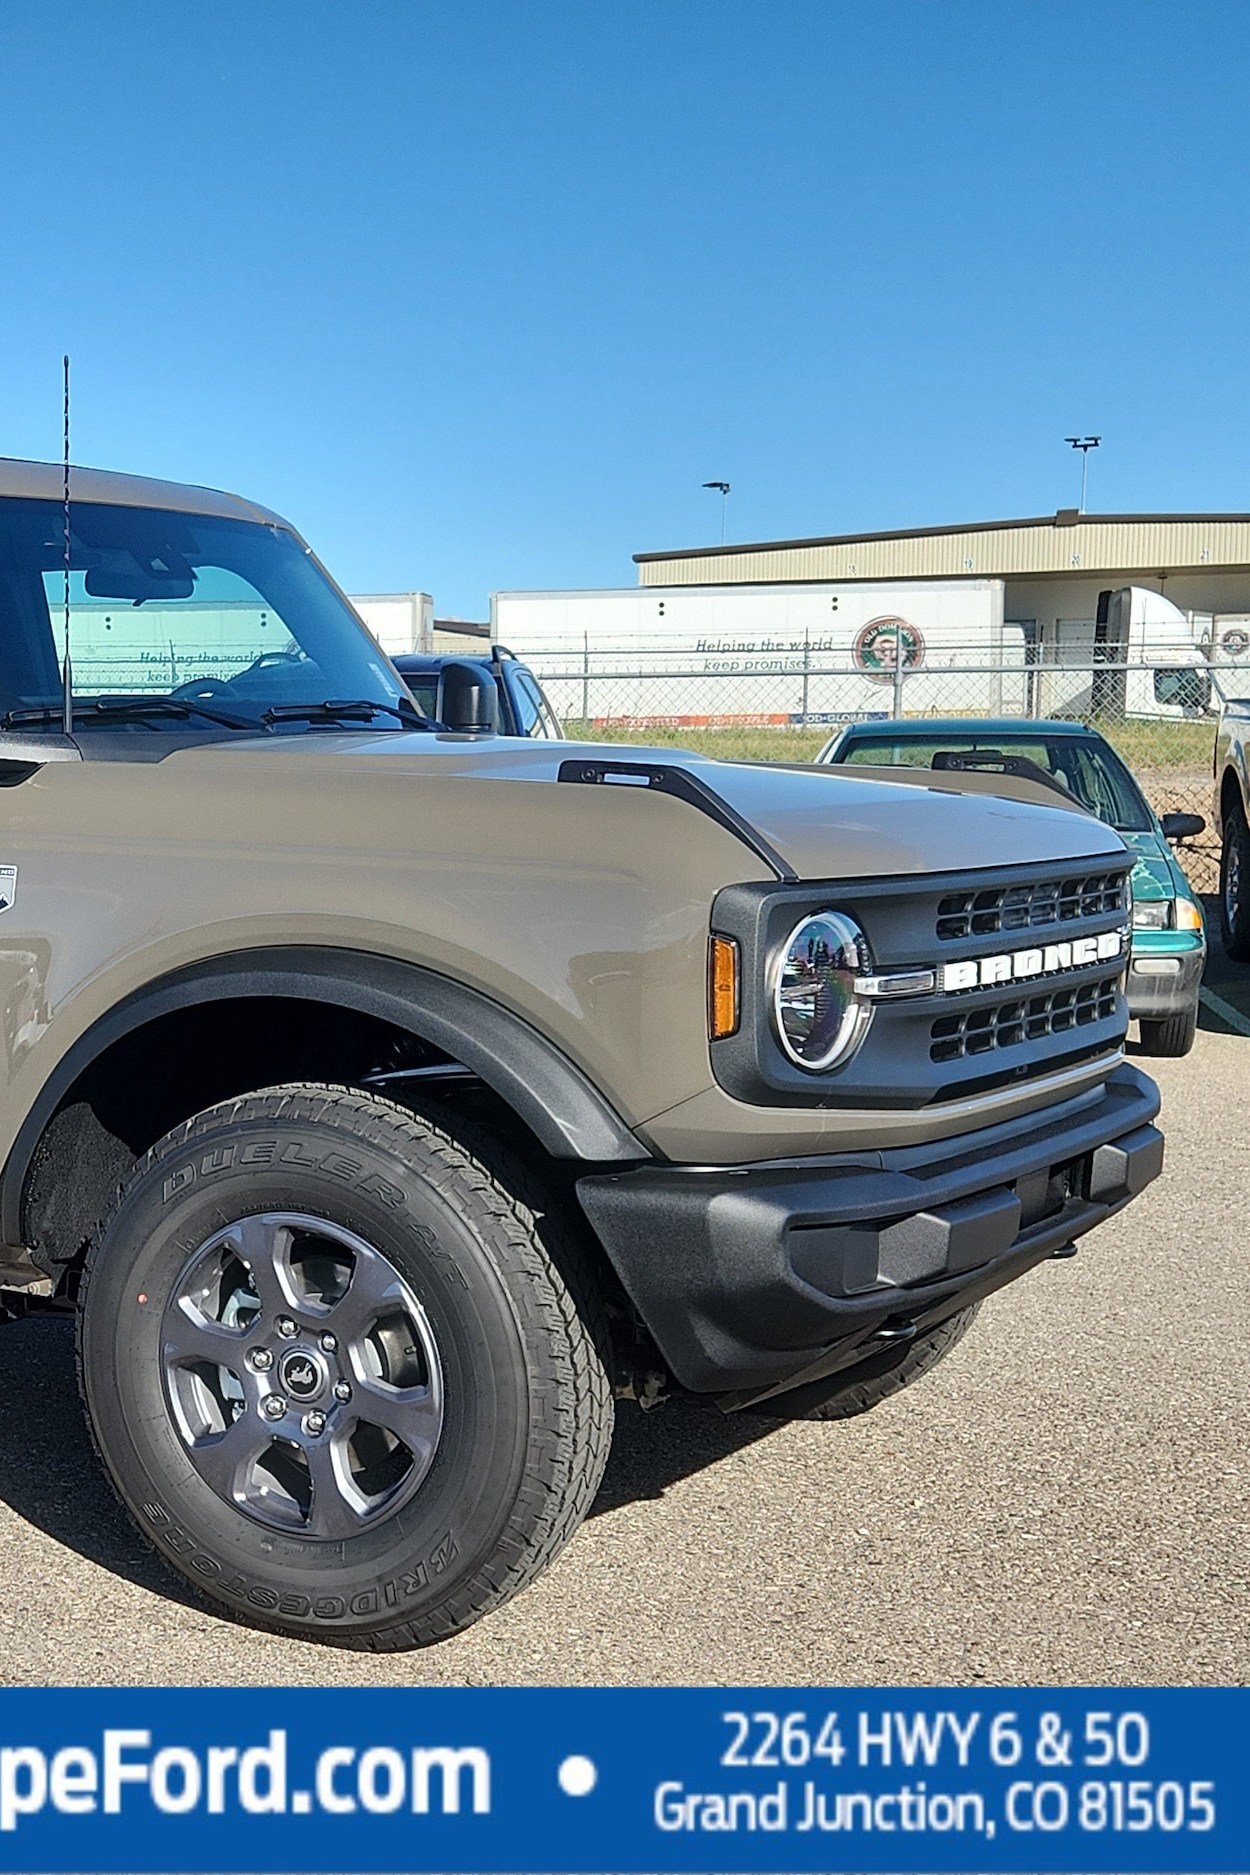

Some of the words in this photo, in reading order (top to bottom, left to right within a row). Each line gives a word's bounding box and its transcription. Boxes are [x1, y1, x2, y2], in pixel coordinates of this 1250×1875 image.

[198, 651, 220, 663] the
[696, 639, 756, 653] Helping
[761, 638, 784, 651] the
[789, 636, 833, 651] world
[703, 658, 740, 672] keep
[943, 931, 1122, 992] BRONCO
[161, 1139, 410, 1206] DUELER
[139, 1500, 461, 1620] BRIDGESTONE
